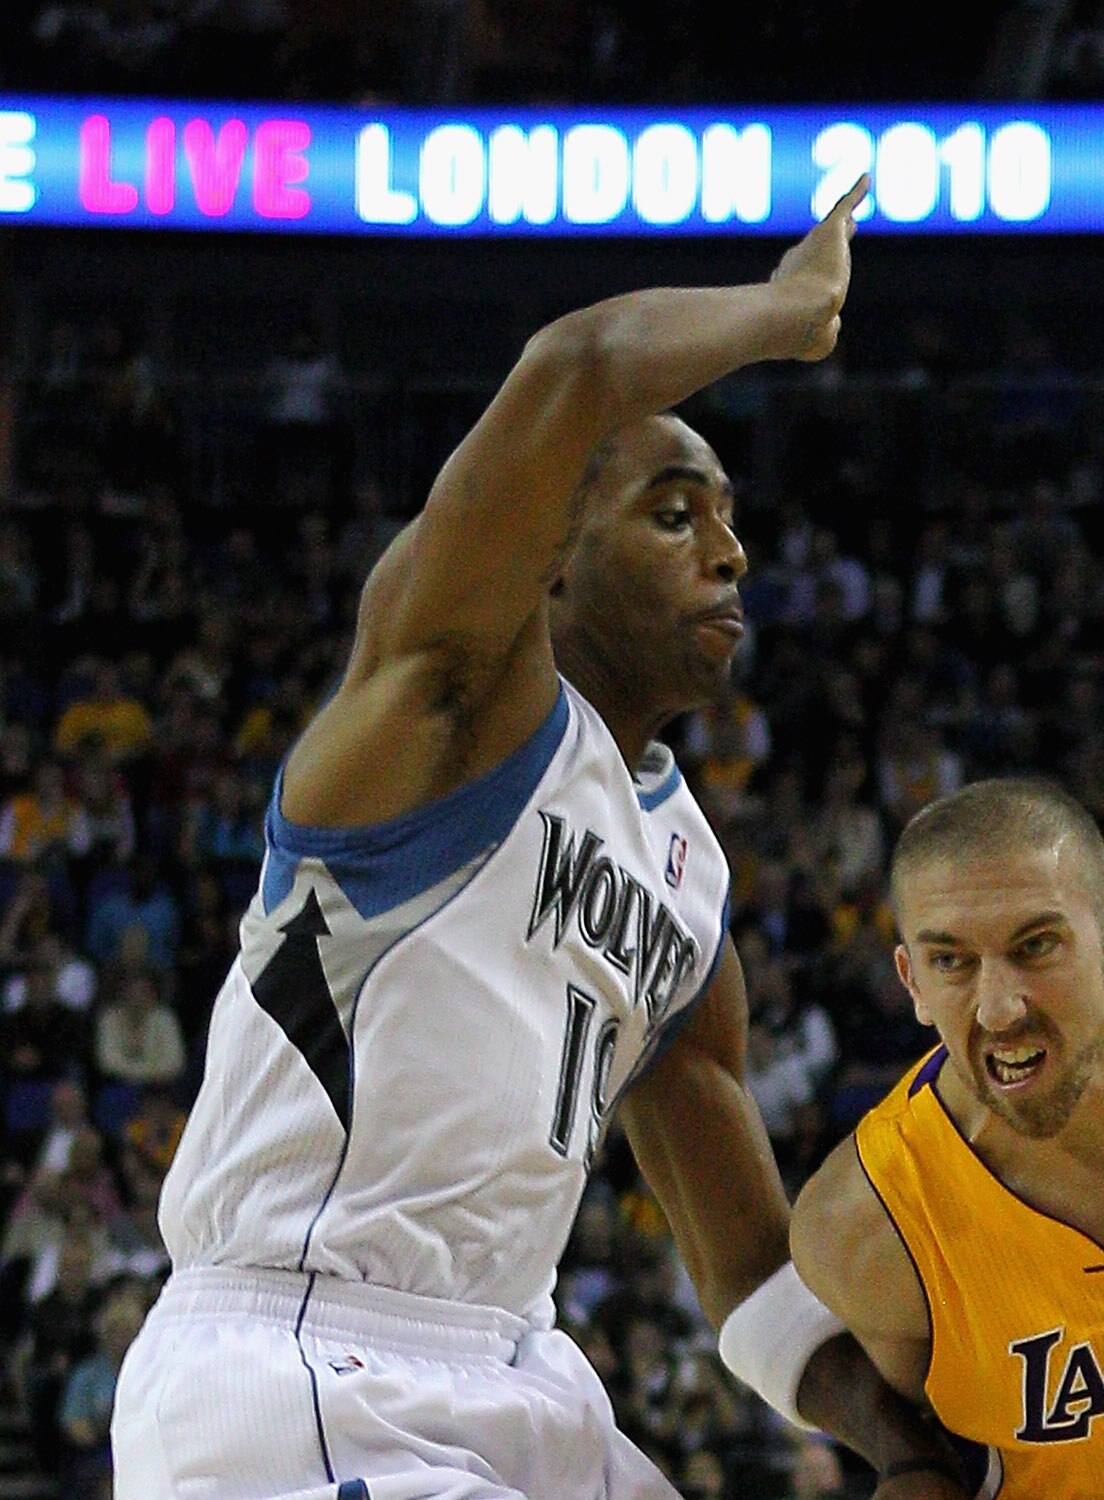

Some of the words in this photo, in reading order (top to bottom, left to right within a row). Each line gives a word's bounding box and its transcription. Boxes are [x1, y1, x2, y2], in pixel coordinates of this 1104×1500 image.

[80, 115, 311, 218] LIVE
[356, 122, 772, 225] LONDON
[811, 120, 1050, 222] 2010
